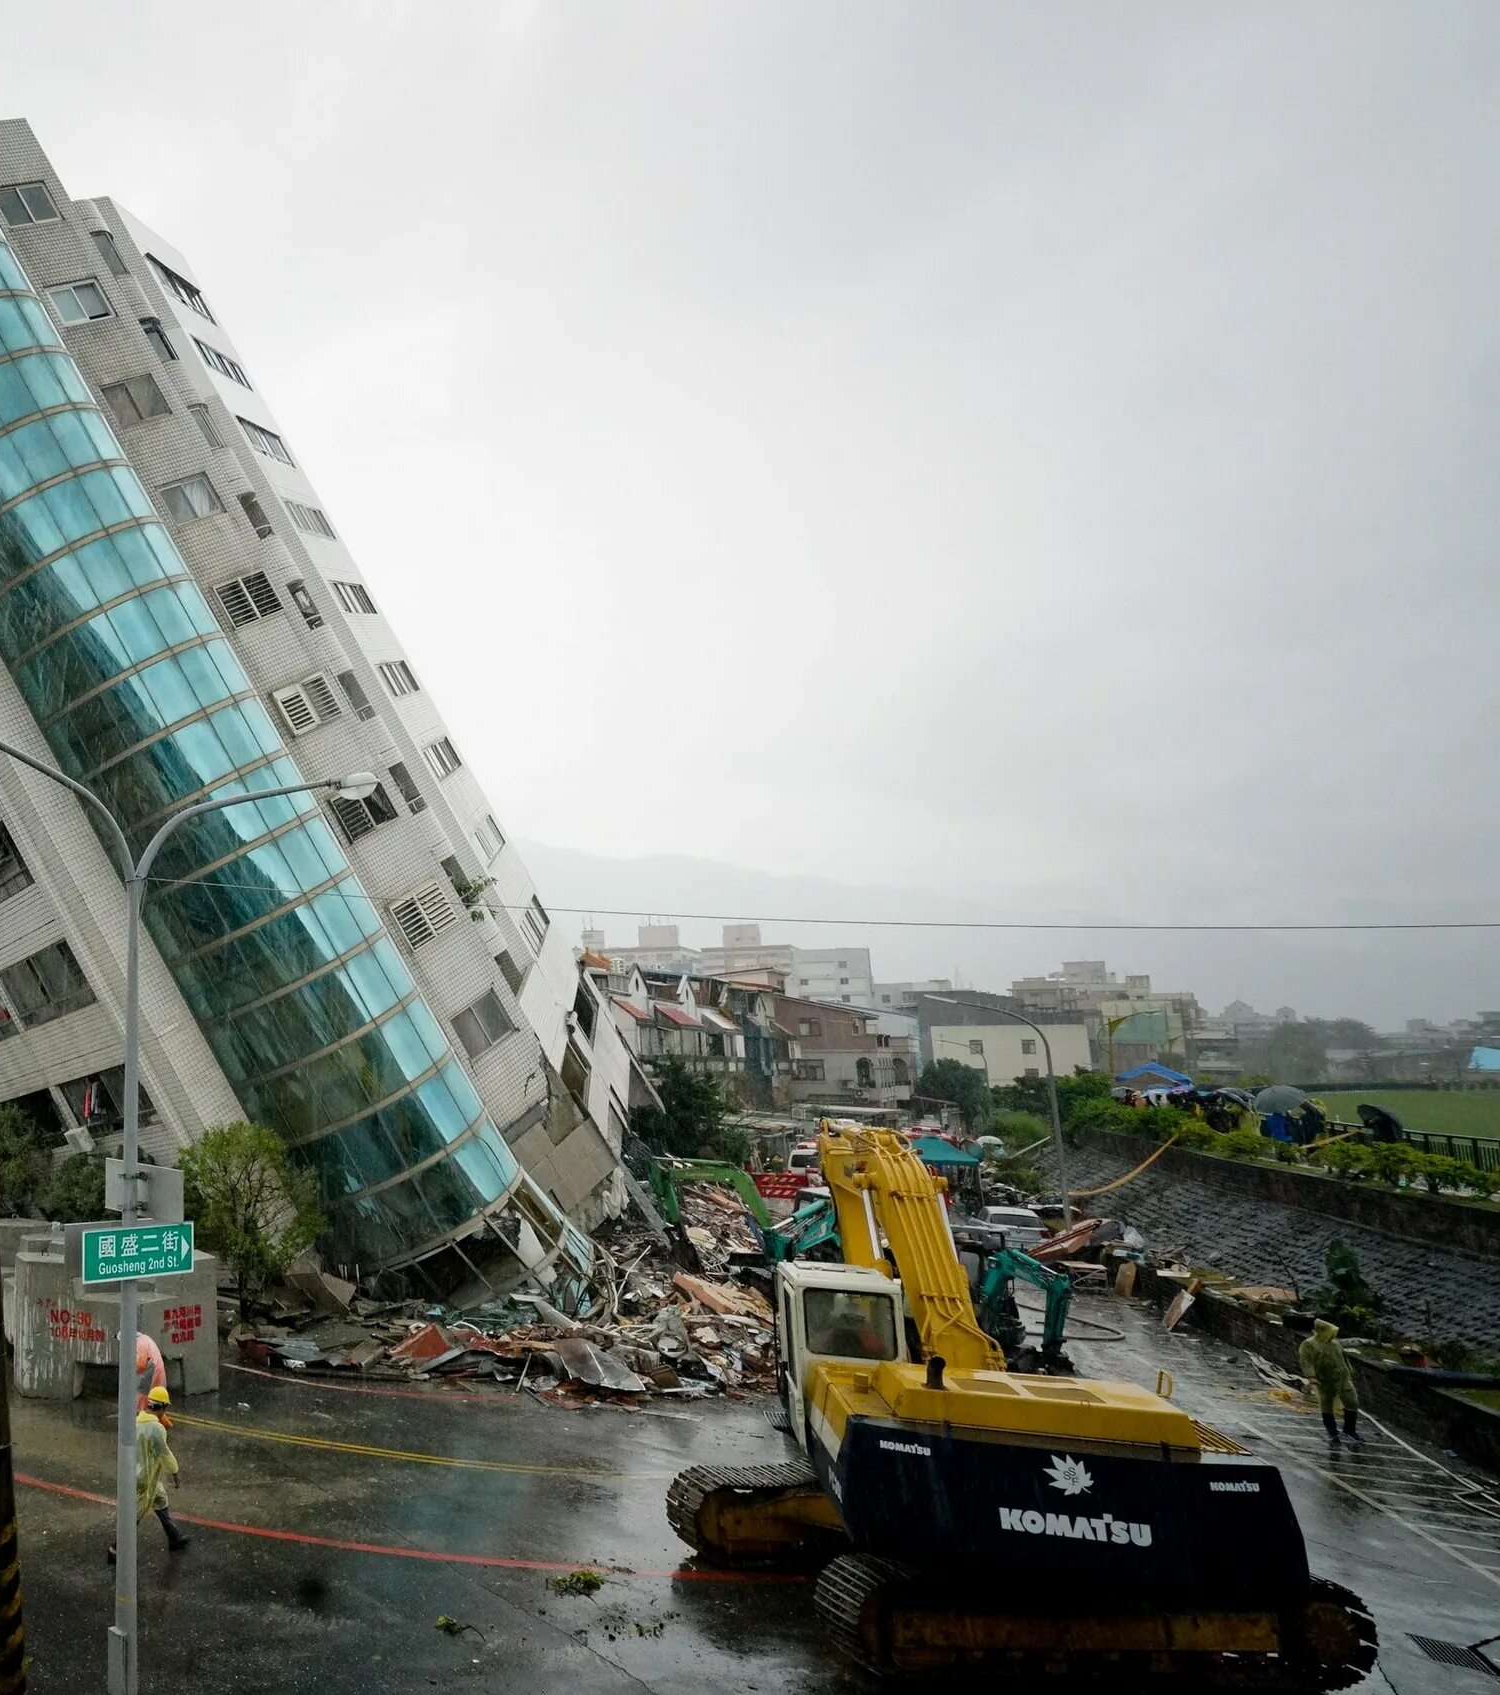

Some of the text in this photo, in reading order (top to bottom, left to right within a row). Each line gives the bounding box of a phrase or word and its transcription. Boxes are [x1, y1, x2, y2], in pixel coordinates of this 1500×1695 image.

[98, 1230, 179, 1259] 國盛二街
[98, 1255, 179, 1275] Guosheng 2nd St.
[879, 1440, 931, 1456] KOMATSU
[1209, 1480, 1260, 1493] KOMATSU
[998, 1507, 1153, 1547] KOMATSU
